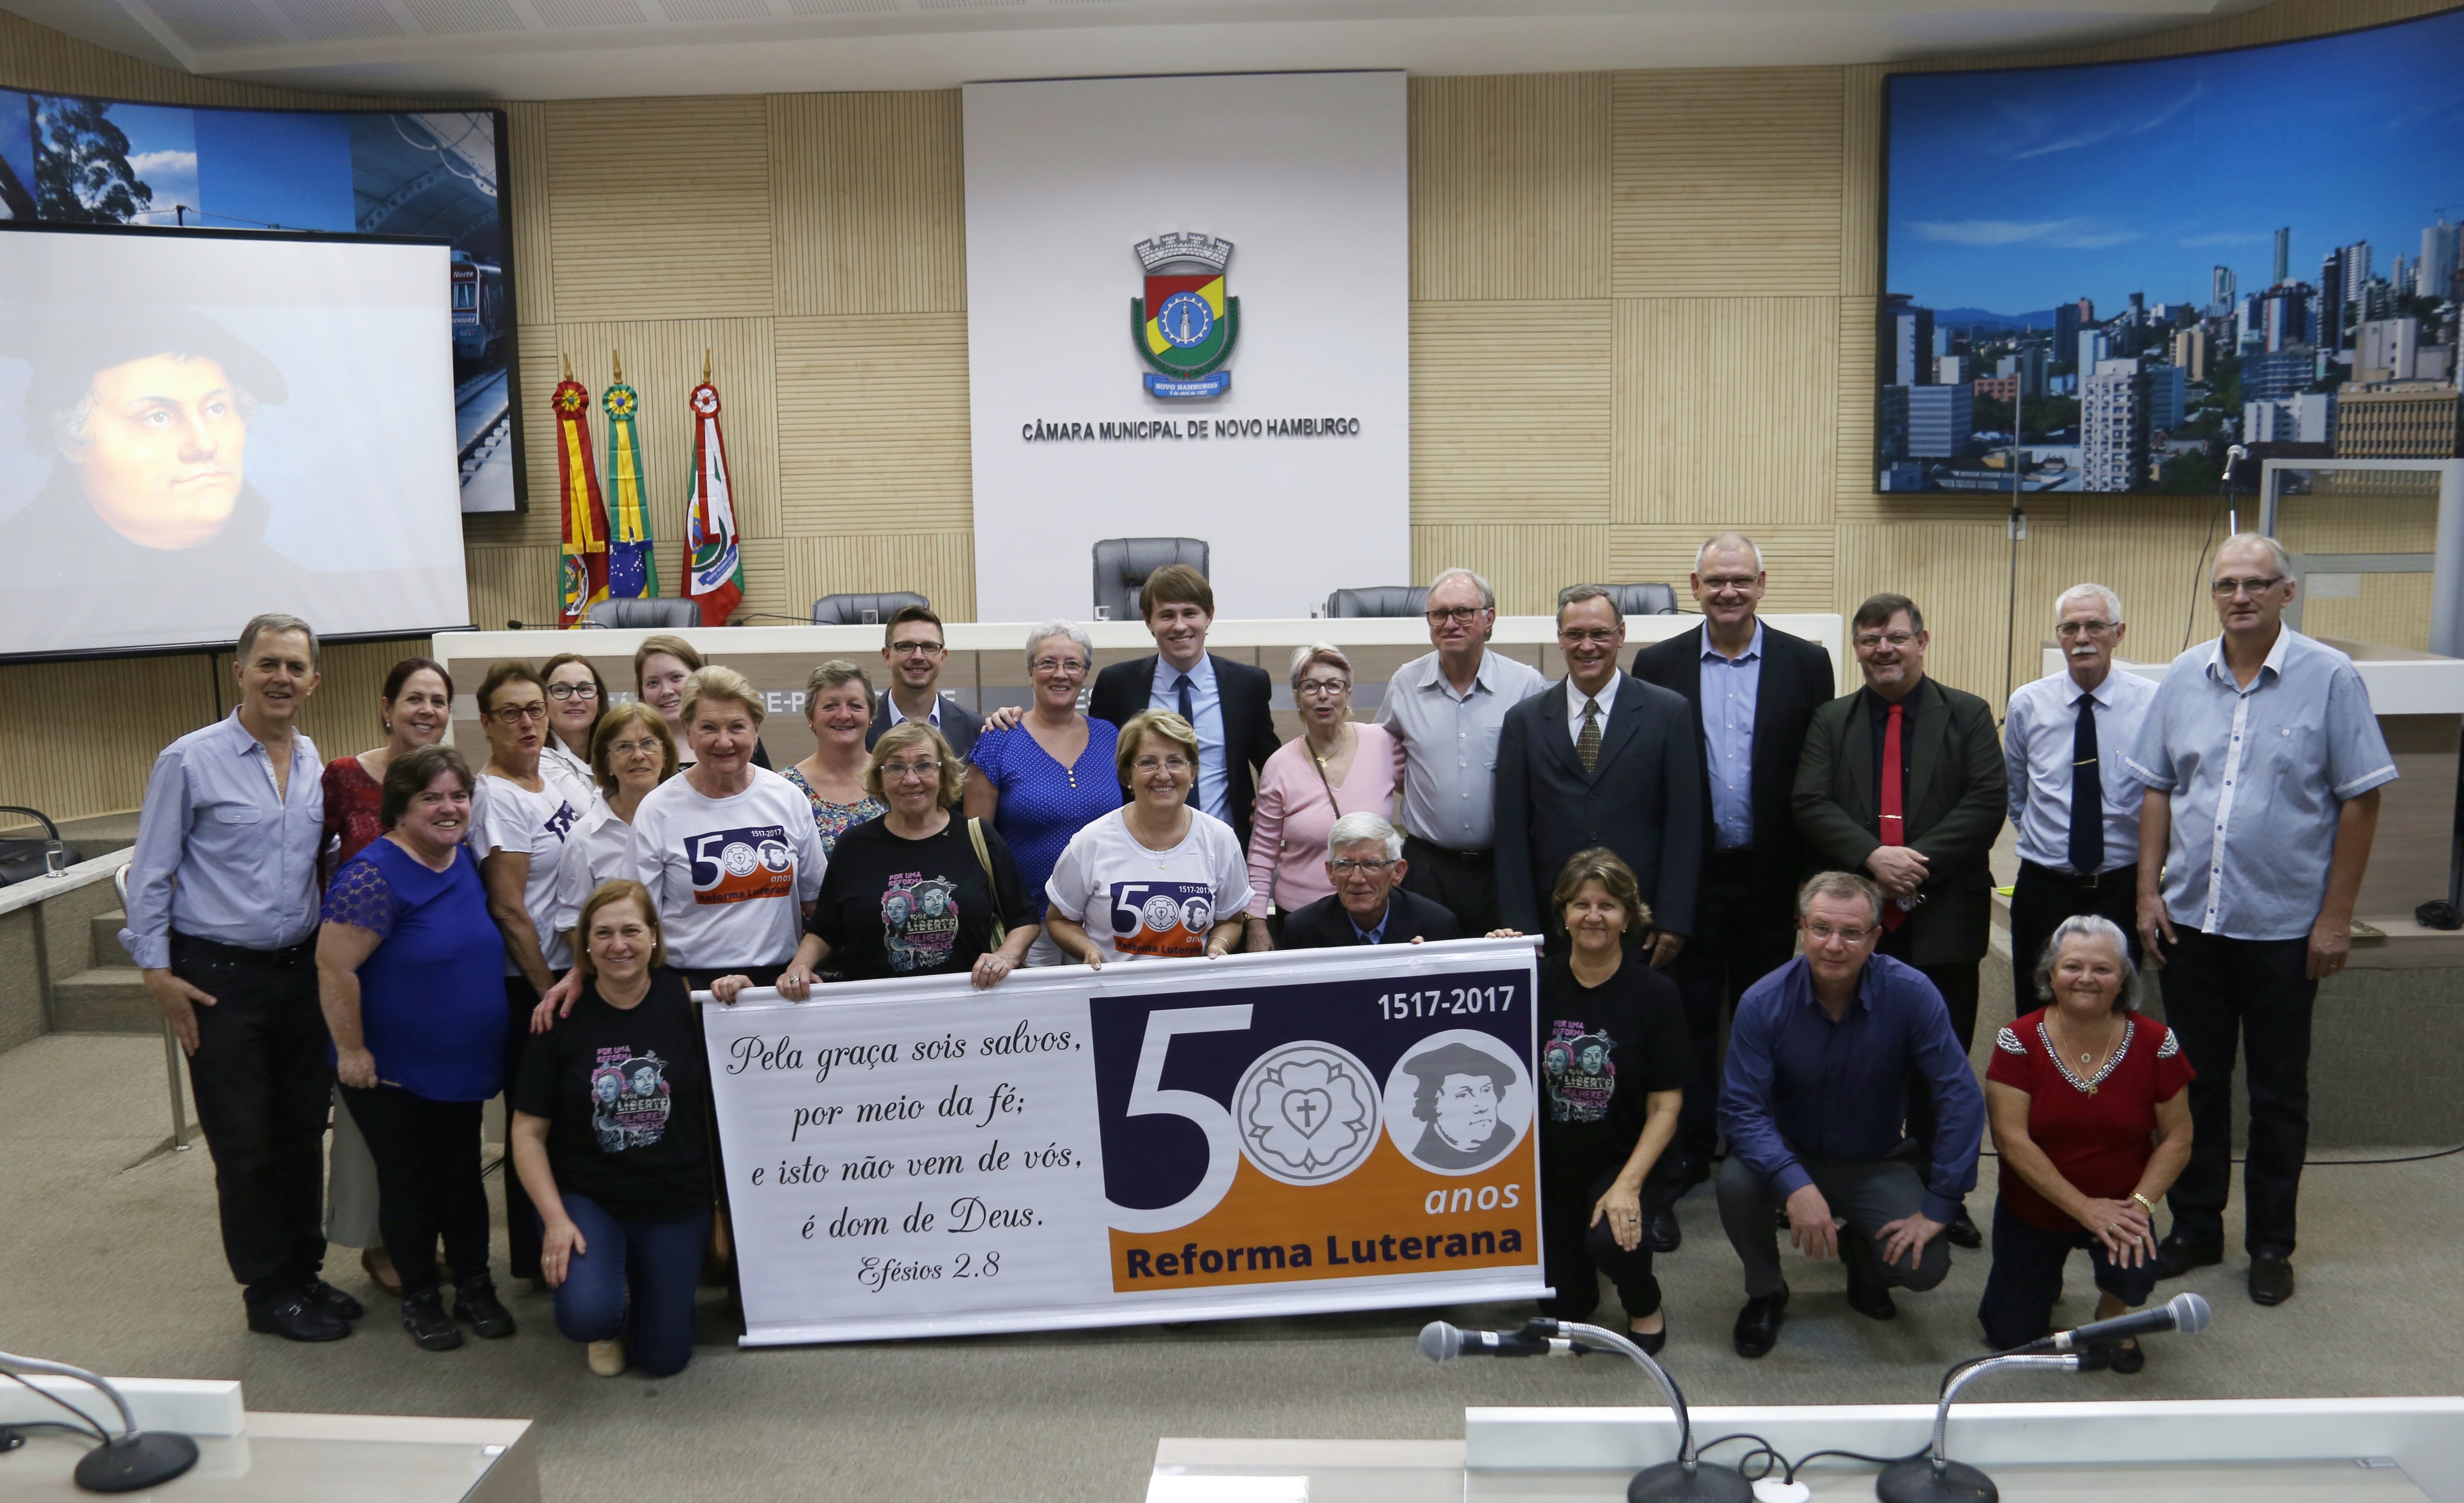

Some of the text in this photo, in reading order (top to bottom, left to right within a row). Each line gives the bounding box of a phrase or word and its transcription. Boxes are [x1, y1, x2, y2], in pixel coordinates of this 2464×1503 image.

[1022, 418, 1360, 441] CÂMARA MUNICIPAL DE NOVO HAMBURGO
[751, 829, 782, 837] 1517-2017
[770, 874, 792, 883] anos
[888, 878, 924, 887] REFORMA
[889, 873, 904, 881] POR
[698, 891, 745, 902] Reforma
[907, 918, 955, 932] LIBERTE
[904, 931, 953, 943] MULHERES
[1118, 940, 1158, 953] Reforma
[1377, 985, 1515, 1020] 1517-2017
[1568, 1021, 1584, 1029] UMA
[1552, 1028, 1585, 1036] REFORMA
[596, 1053, 632, 1063] REFORMA
[727, 1020, 1082, 1083] Pela graça sois salvos,
[1564, 1076, 1612, 1088] LIBERTE
[1561, 1088, 1609, 1099] MULHERES
[617, 1098, 667, 1112] LIBERTE
[791, 1083, 1025, 1141] por meio da fé;
[752, 1140, 1082, 1186] e isto não vem de vós,
[1424, 1183, 1520, 1215] anos
[802, 1196, 1043, 1240] é dom de Deus.
[1126, 1228, 1522, 1279] Reforma Luterana
[857, 1251, 1000, 1293] Efésios 2.8
